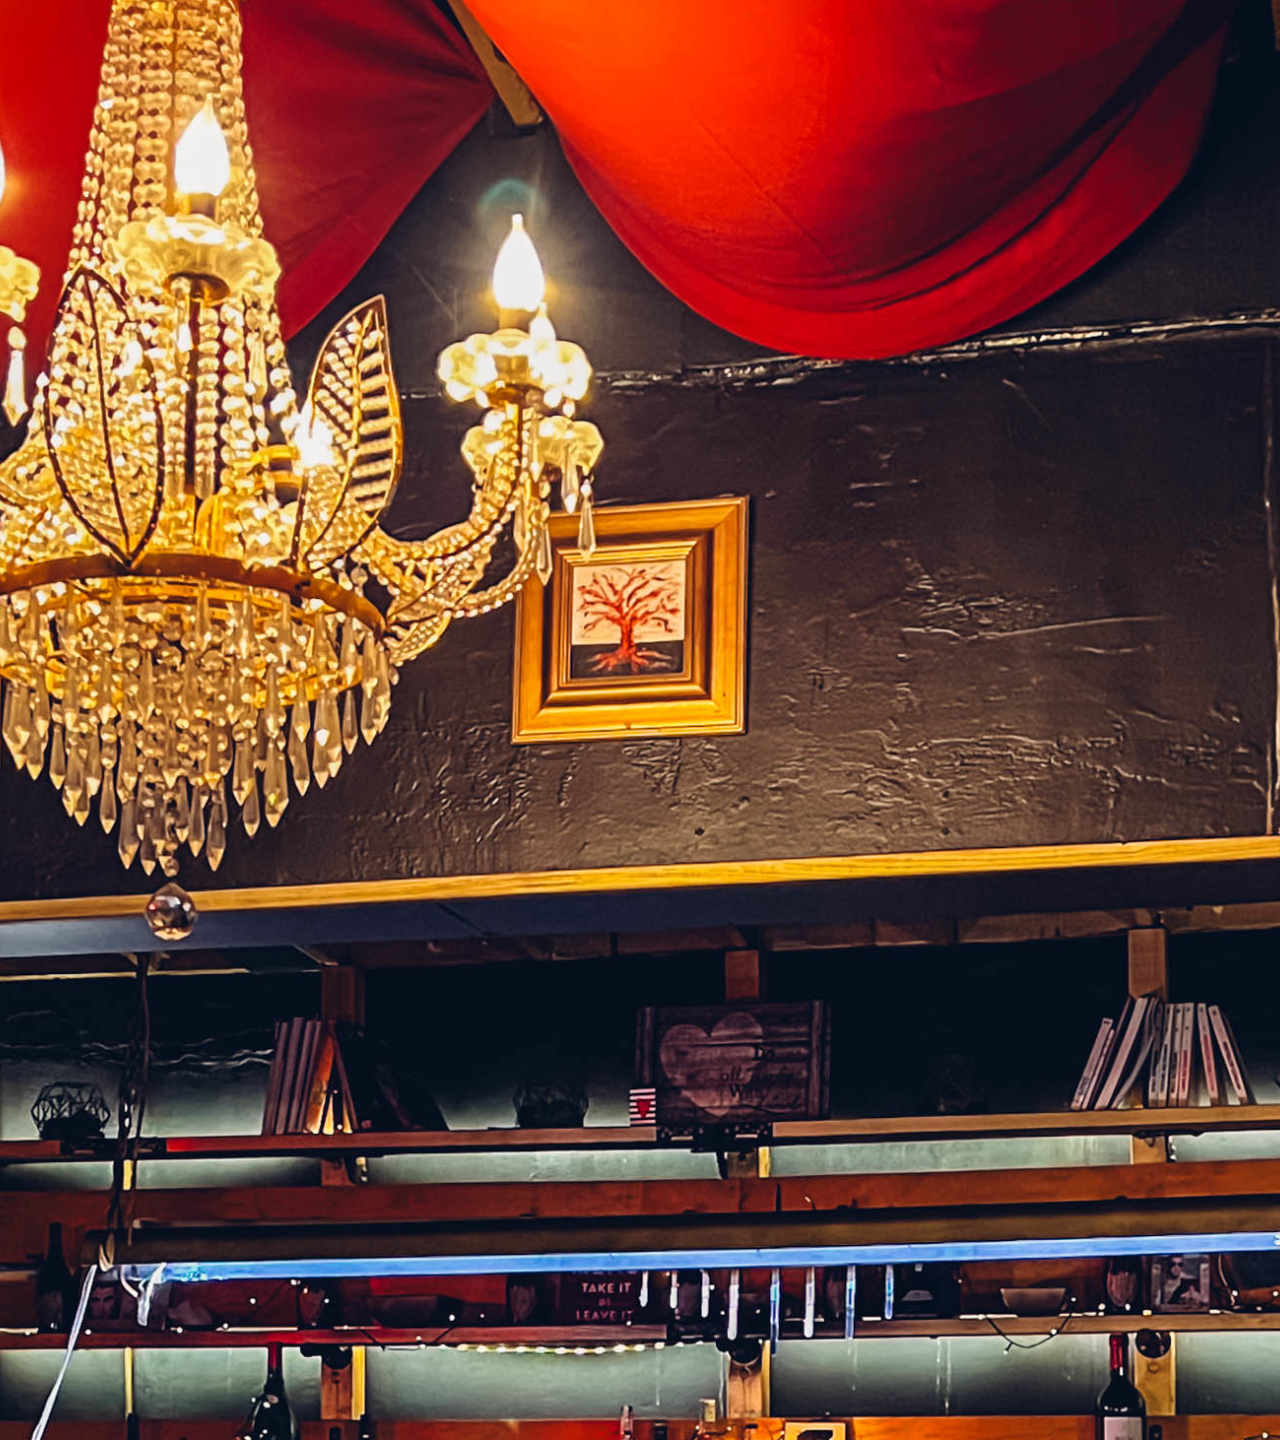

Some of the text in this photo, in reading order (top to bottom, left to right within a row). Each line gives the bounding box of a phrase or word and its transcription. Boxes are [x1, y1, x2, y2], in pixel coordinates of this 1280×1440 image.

[582, 1282, 631, 1293] TAKE IT
[576, 1310, 633, 1320] LEAVE IT
